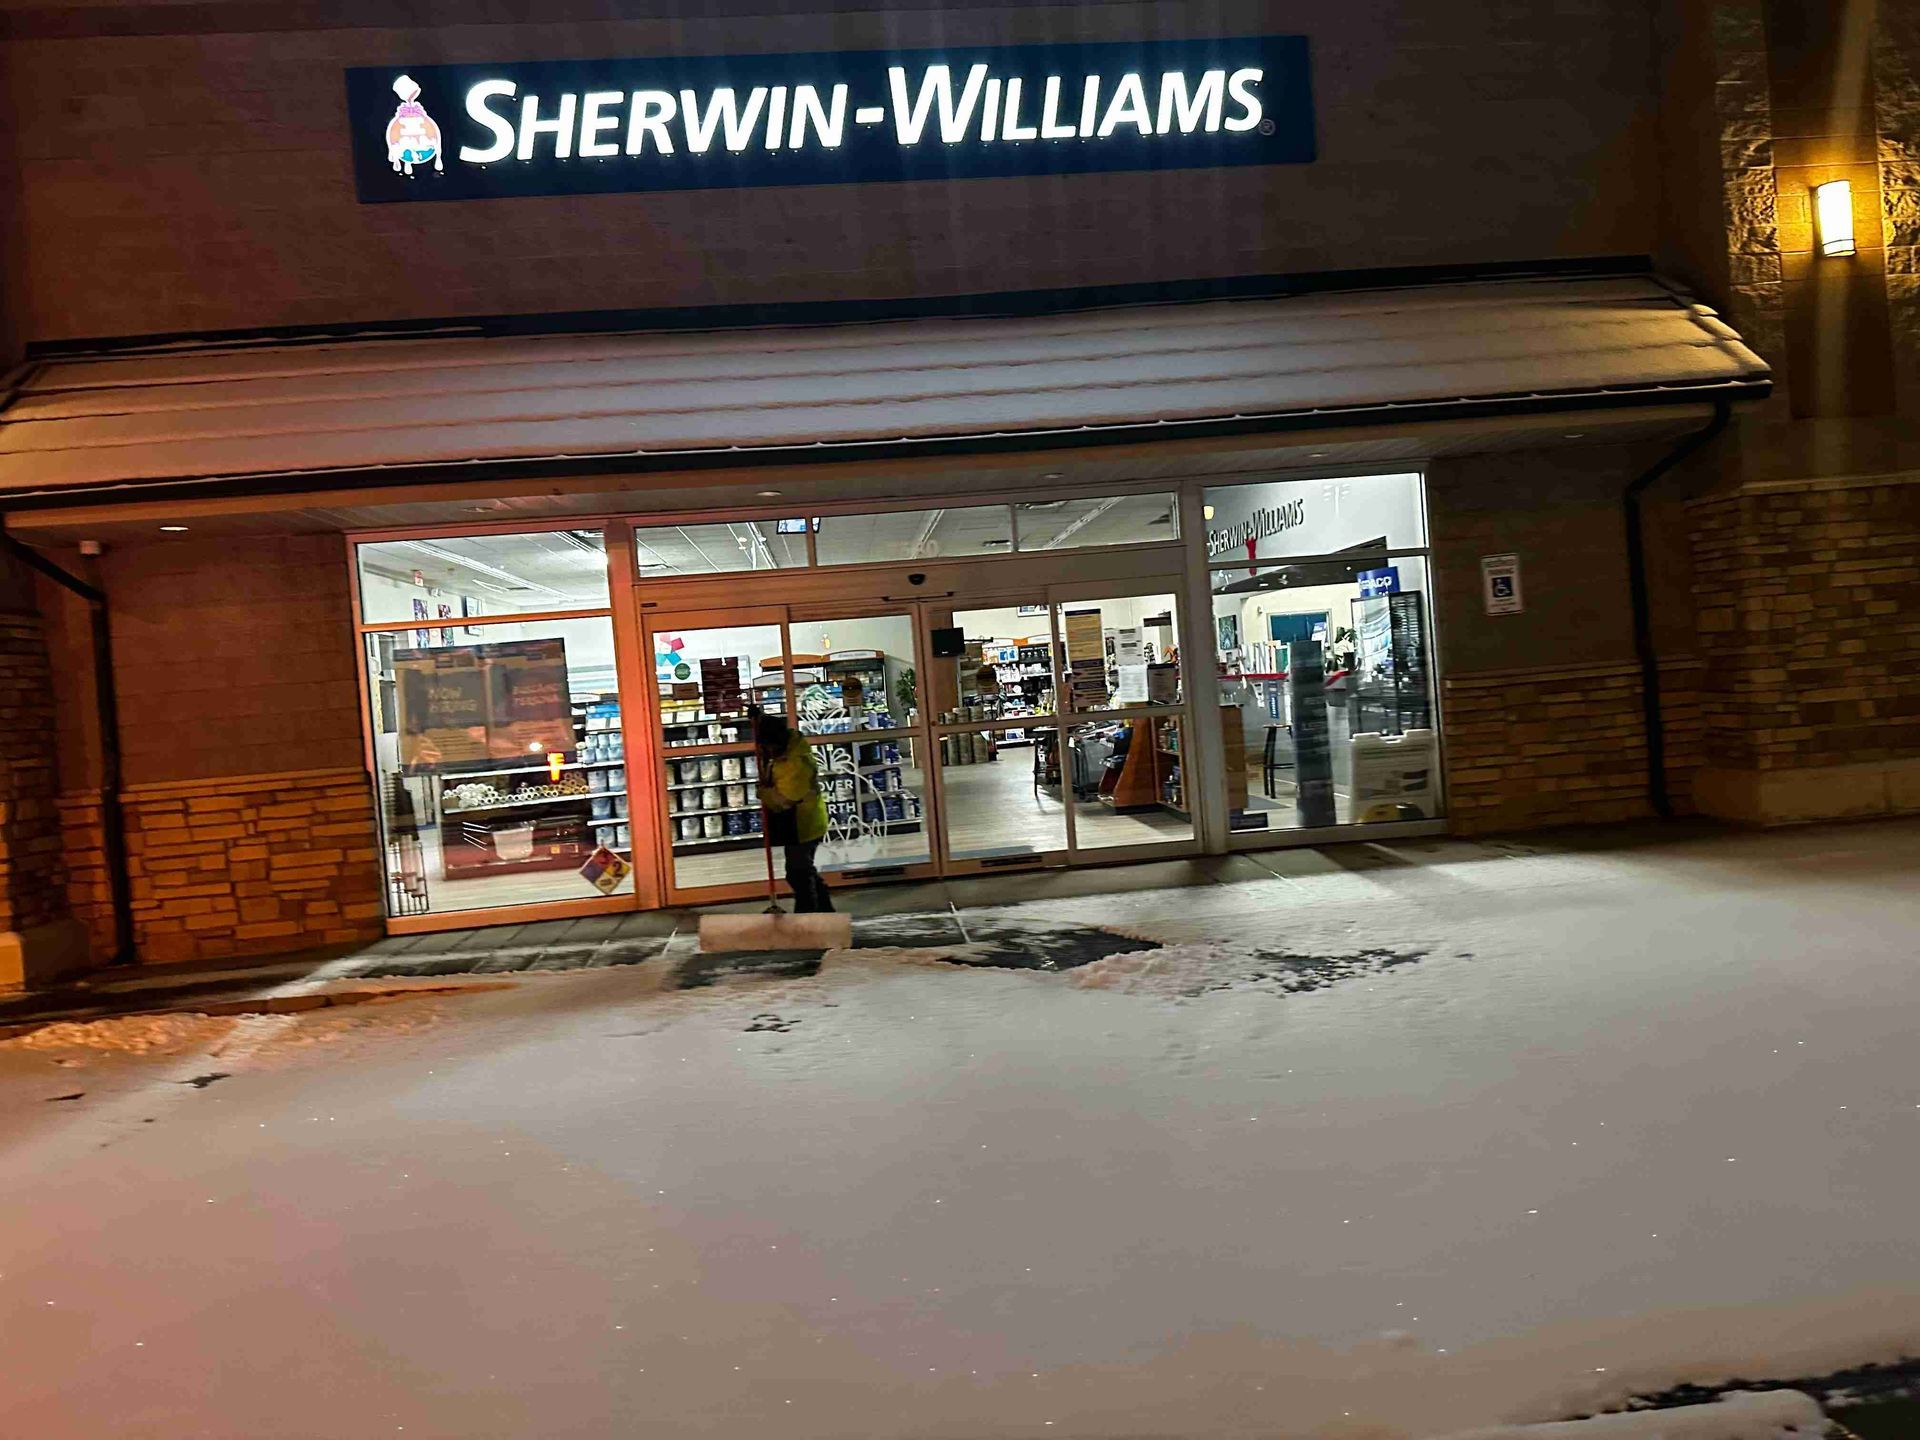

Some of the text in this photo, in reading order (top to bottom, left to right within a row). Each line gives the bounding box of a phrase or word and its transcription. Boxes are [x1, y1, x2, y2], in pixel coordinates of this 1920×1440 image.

[459, 63, 1264, 163] SHERWIN-WILLIAMS
[1208, 498, 1304, 557] SHERWIN-WILLIAMS
[817, 778, 854, 792] OVER
[827, 801, 857, 815] RTH
